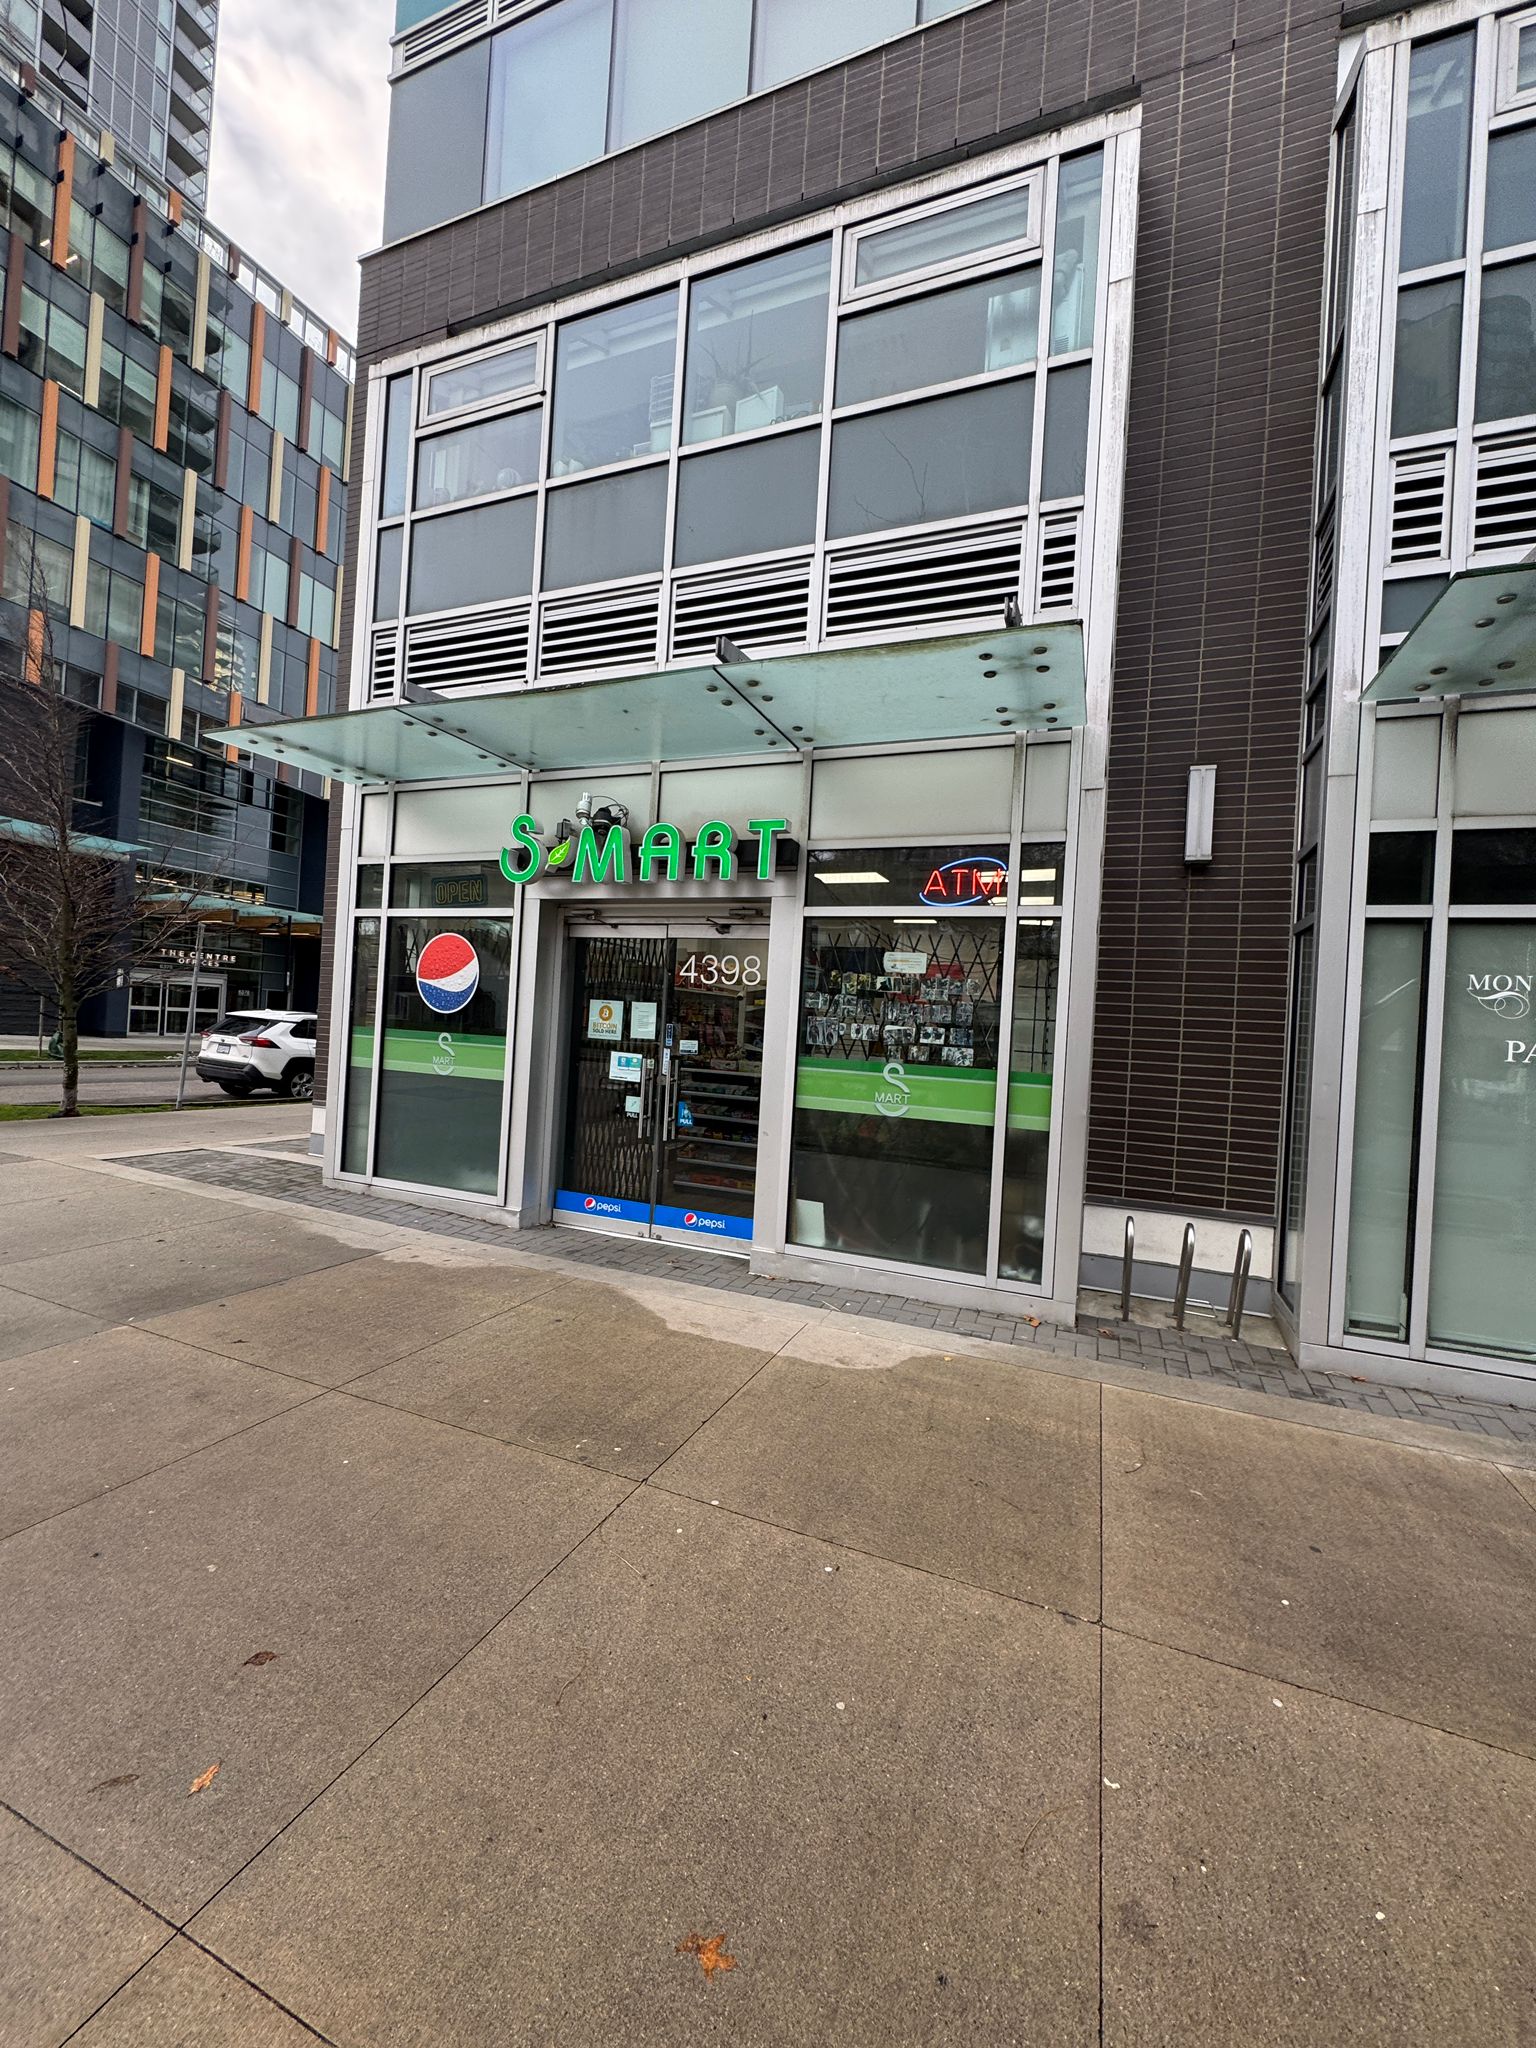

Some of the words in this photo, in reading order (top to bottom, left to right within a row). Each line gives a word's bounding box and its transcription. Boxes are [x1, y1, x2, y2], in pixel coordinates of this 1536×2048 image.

[500, 813, 542, 884] S
[571, 818, 790, 883] MART
[923, 868, 1004, 896] ATM
[434, 879, 483, 904] OPEN
[160, 948, 185, 958] THE
[178, 958, 220, 967] OFFCES
[679, 954, 761, 986] 4398
[1466, 974, 1533, 991] MON
[593, 1022, 618, 1030] BITCOIN
[432, 1055, 456, 1066] MART
[874, 1091, 911, 1105] MART
[596, 1201, 622, 1213] pepsi
[698, 1217, 726, 1229] pepsi
